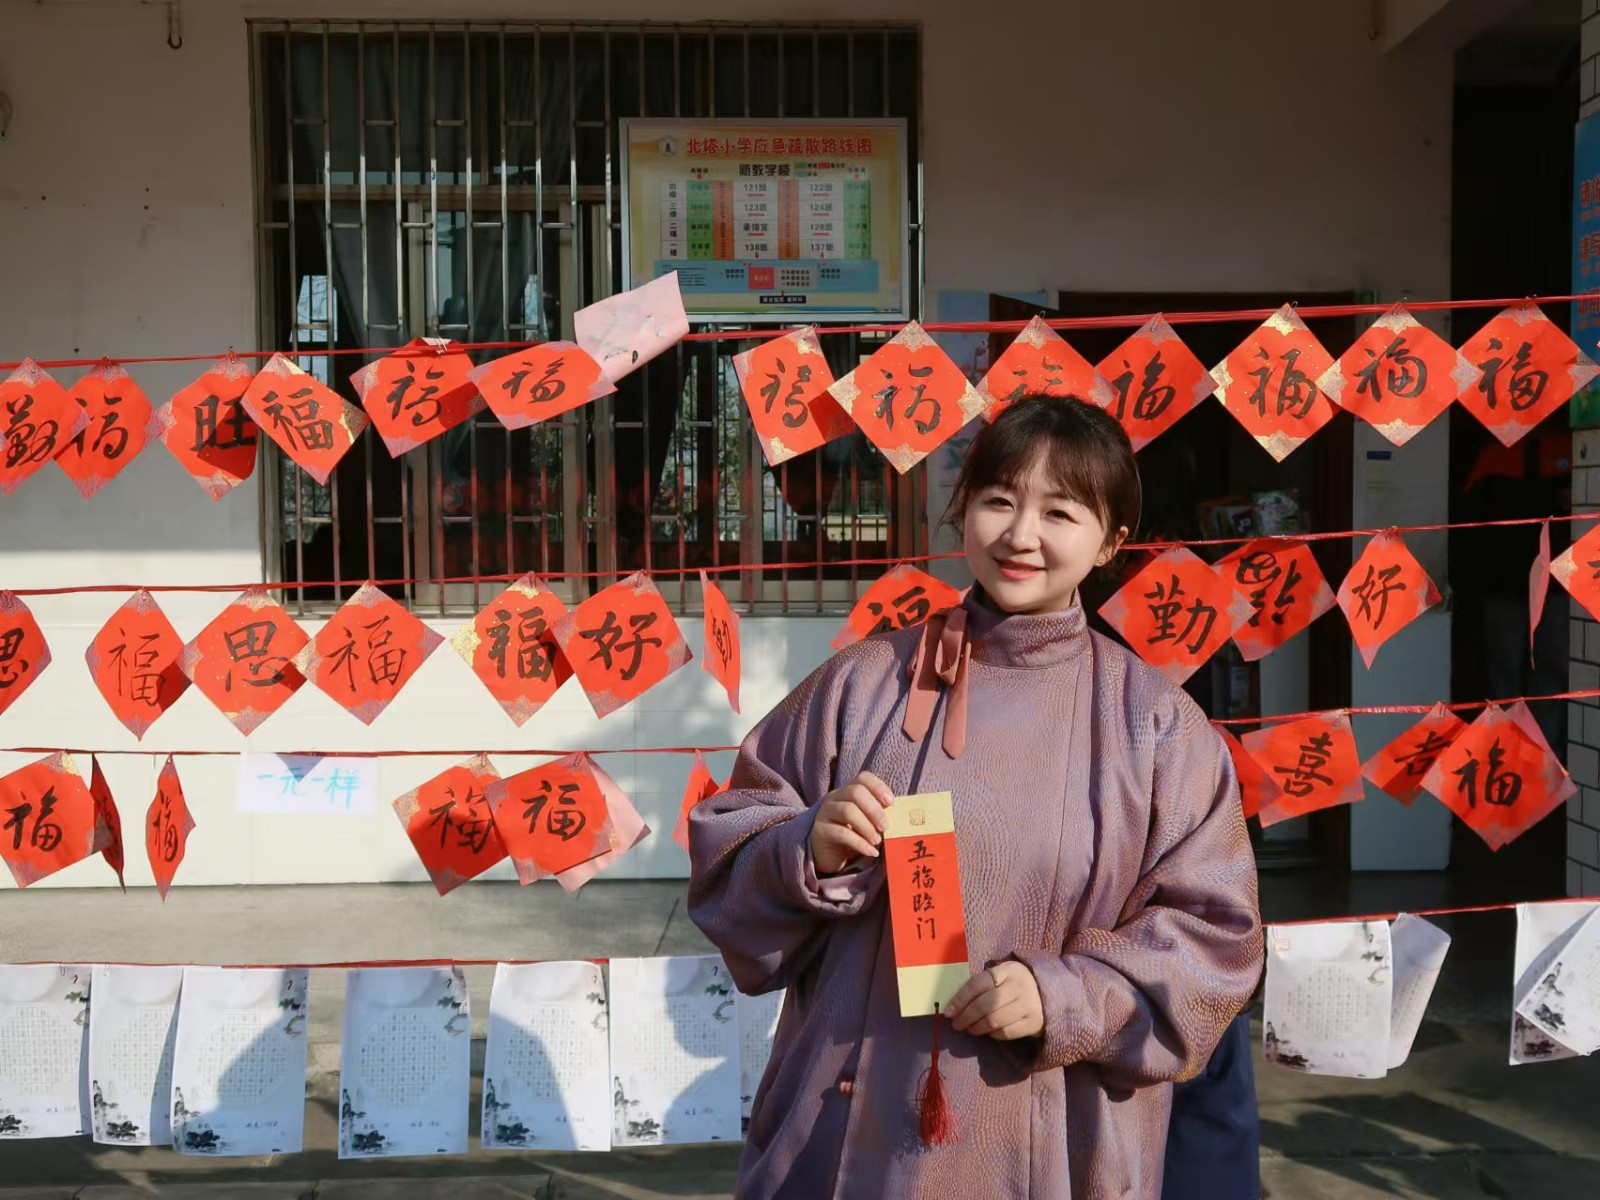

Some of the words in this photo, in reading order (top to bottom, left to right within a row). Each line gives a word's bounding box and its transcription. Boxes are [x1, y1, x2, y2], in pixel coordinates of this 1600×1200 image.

[686, 136, 872, 155] 北塔小学应急疏散路线图
[739, 163, 790, 177] 新教学楼
[743, 183, 768, 193] 121班
[743, 203, 768, 213] 123班
[809, 183, 833, 193] 122班
[809, 203, 834, 213] 124班
[387, 359, 444, 426] 福
[502, 357, 566, 403] 福
[760, 358, 812, 428] 福
[872, 364, 941, 435] 福
[1113, 351, 1177, 421] 福
[1248, 347, 1317, 419] 福
[1357, 337, 1428, 403] 福
[1479, 338, 1549, 411] 福
[71, 394, 129, 459] 福
[262, 388, 334, 452] 福
[1143, 574, 1218, 655] 勤
[1350, 564, 1407, 631] 好
[107, 627, 166, 707] 福
[326, 615, 408, 692] 福
[485, 606, 556, 682] 福
[578, 611, 663, 681] 好
[256, 767, 360, 810] 一元一样
[1272, 731, 1335, 798] 喜
[1451, 737, 1523, 809] 福
[3, 786, 63, 851] 福
[151, 789, 179, 863] 福
[429, 786, 494, 855] 福
[520, 779, 587, 842] 福
